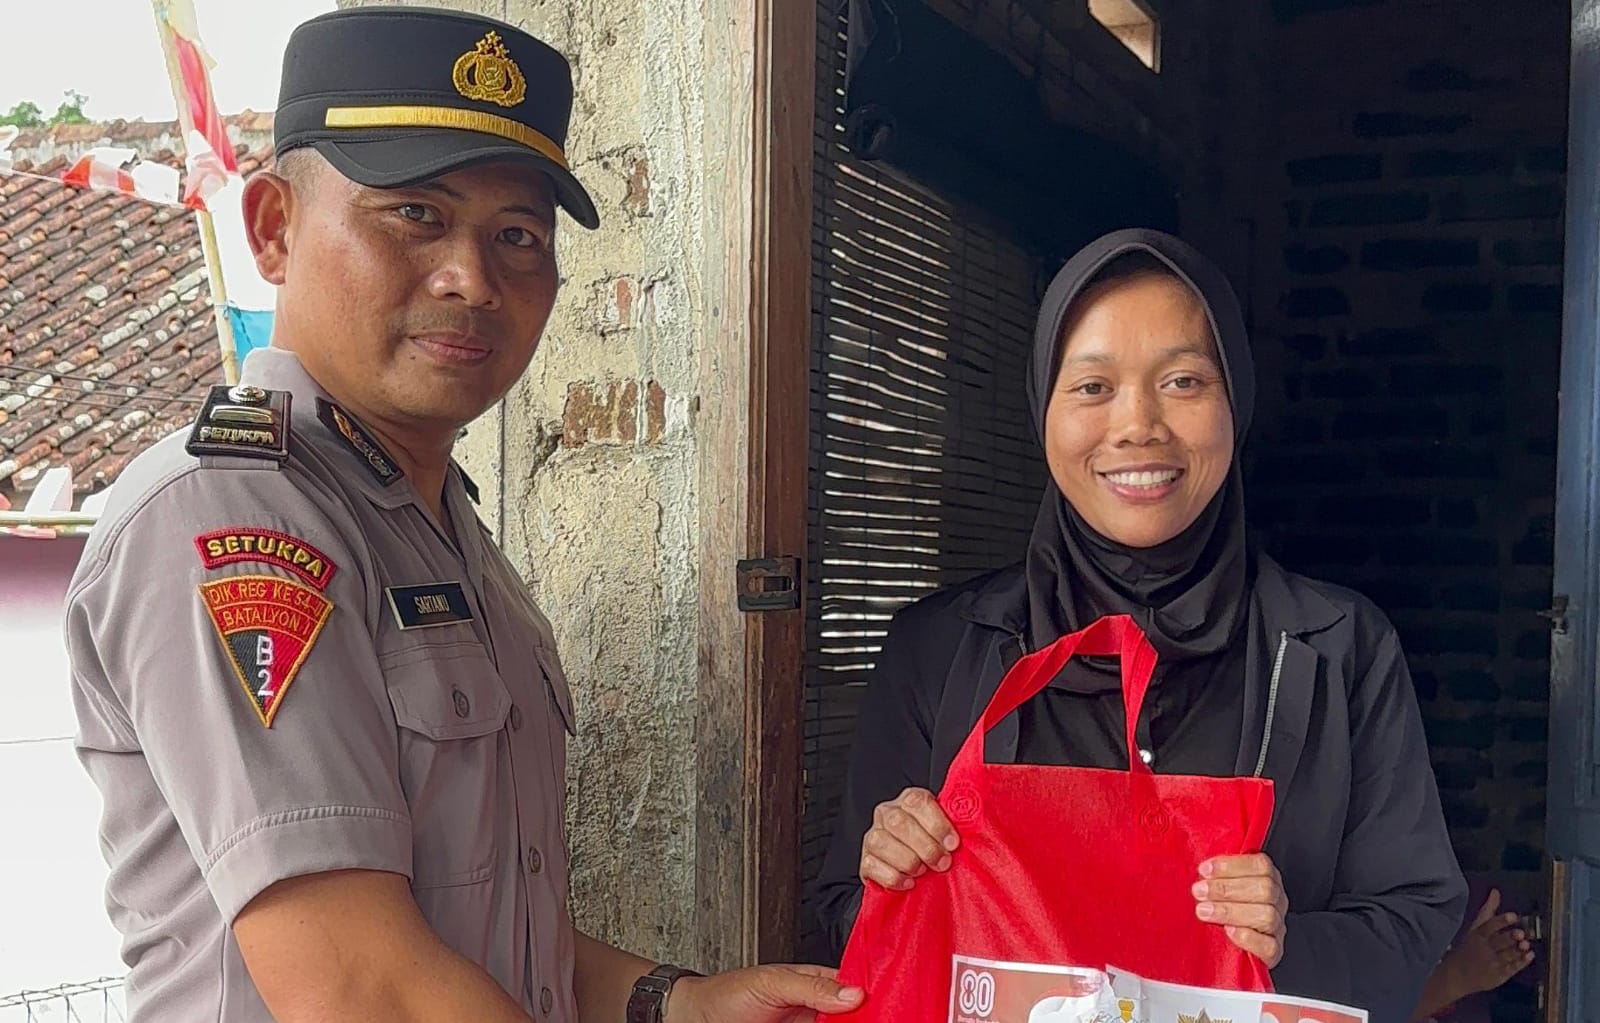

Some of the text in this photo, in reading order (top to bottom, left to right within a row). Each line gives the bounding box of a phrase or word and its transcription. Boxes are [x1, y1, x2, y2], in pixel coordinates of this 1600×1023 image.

[207, 536, 322, 578] SETUKPA
[209, 585, 232, 604] DIK
[239, 582, 266, 599] REG
[273, 583, 293, 601] KE
[223, 607, 301, 632] BATALYON
[256, 635, 274, 666] B
[257, 669, 274, 697] 2
[959, 969, 995, 1017] 80
